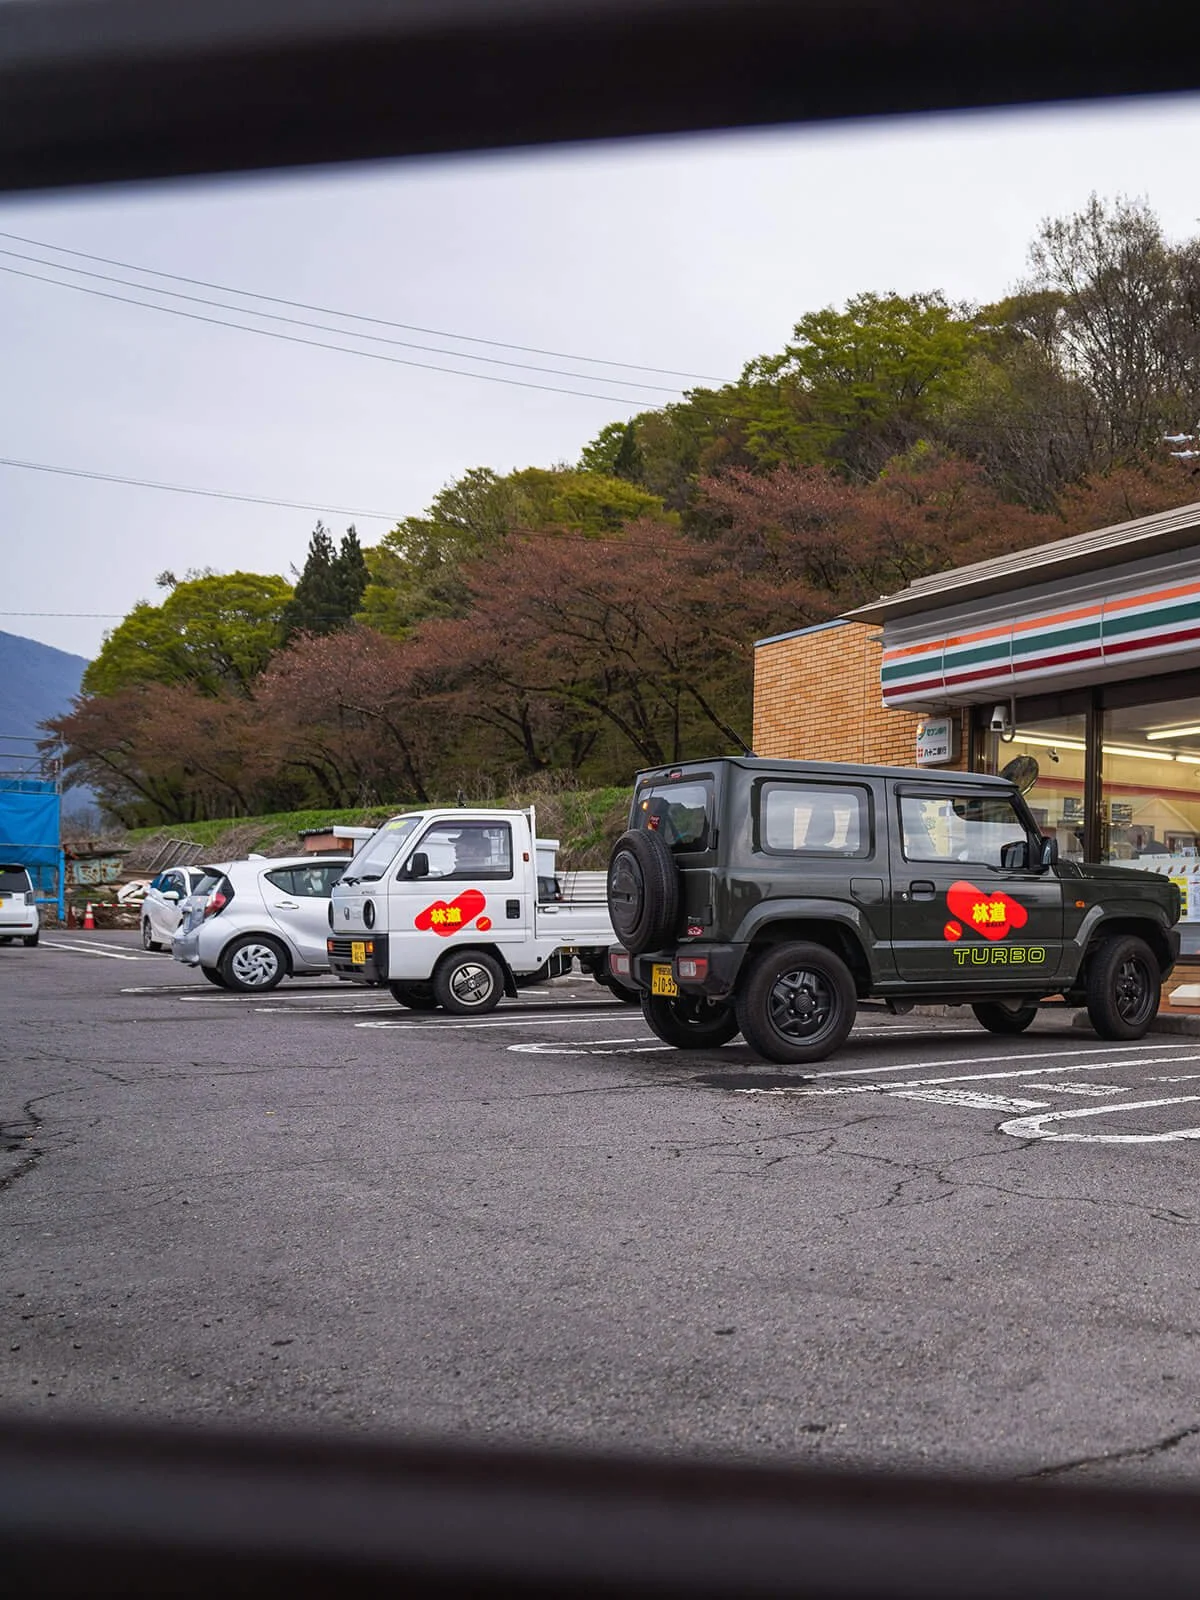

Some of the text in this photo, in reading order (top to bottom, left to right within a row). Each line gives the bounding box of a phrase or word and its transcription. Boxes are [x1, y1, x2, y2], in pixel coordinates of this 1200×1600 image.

[431, 907, 462, 925] 林道
[972, 902, 1006, 923] 林道
[953, 947, 1046, 965] TURBO
